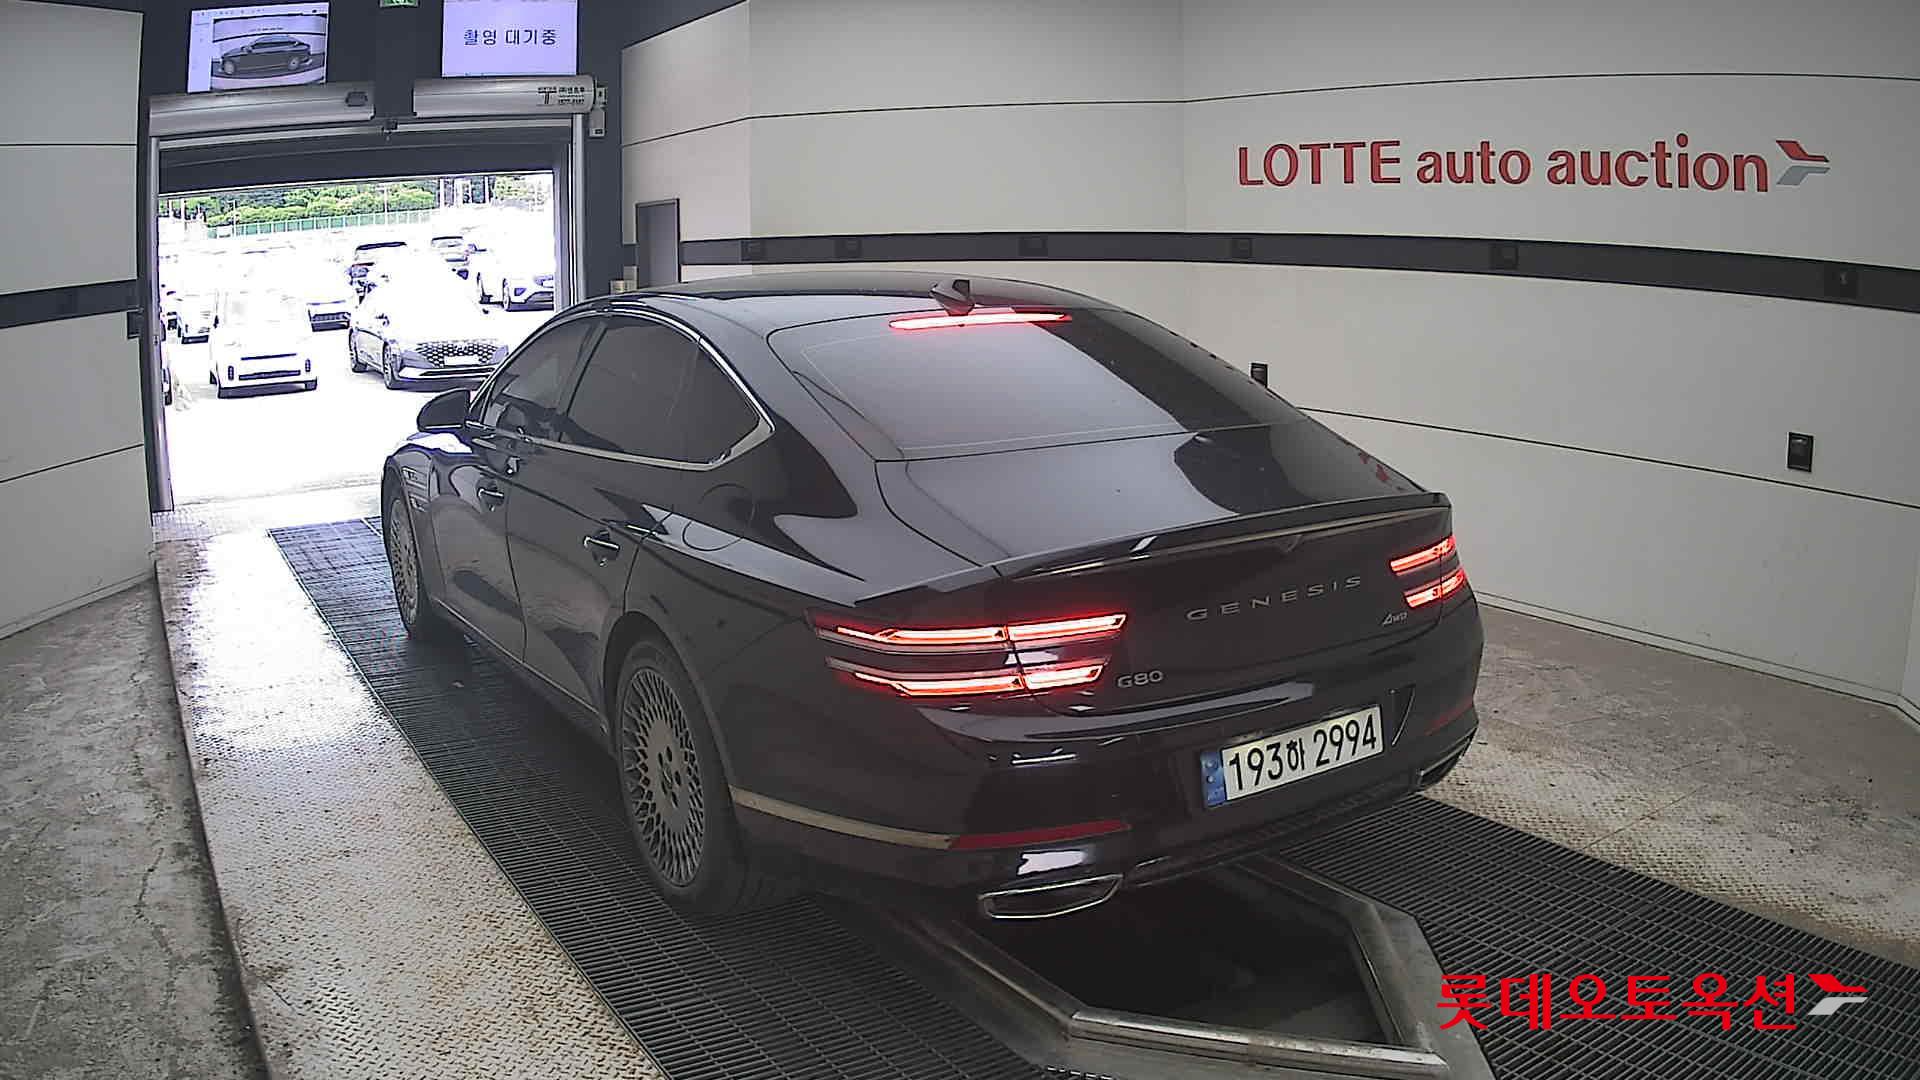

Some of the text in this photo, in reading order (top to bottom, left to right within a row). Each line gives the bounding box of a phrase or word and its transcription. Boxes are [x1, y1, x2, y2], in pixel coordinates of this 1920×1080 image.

[463, 29, 557, 46] 촬영 대기중
[1238, 133, 1769, 193] LOTTE auto auction
[1186, 576, 1361, 621] GENESIS
[1117, 670, 1164, 688] G80
[1229, 714, 1377, 791] 193하 2994
